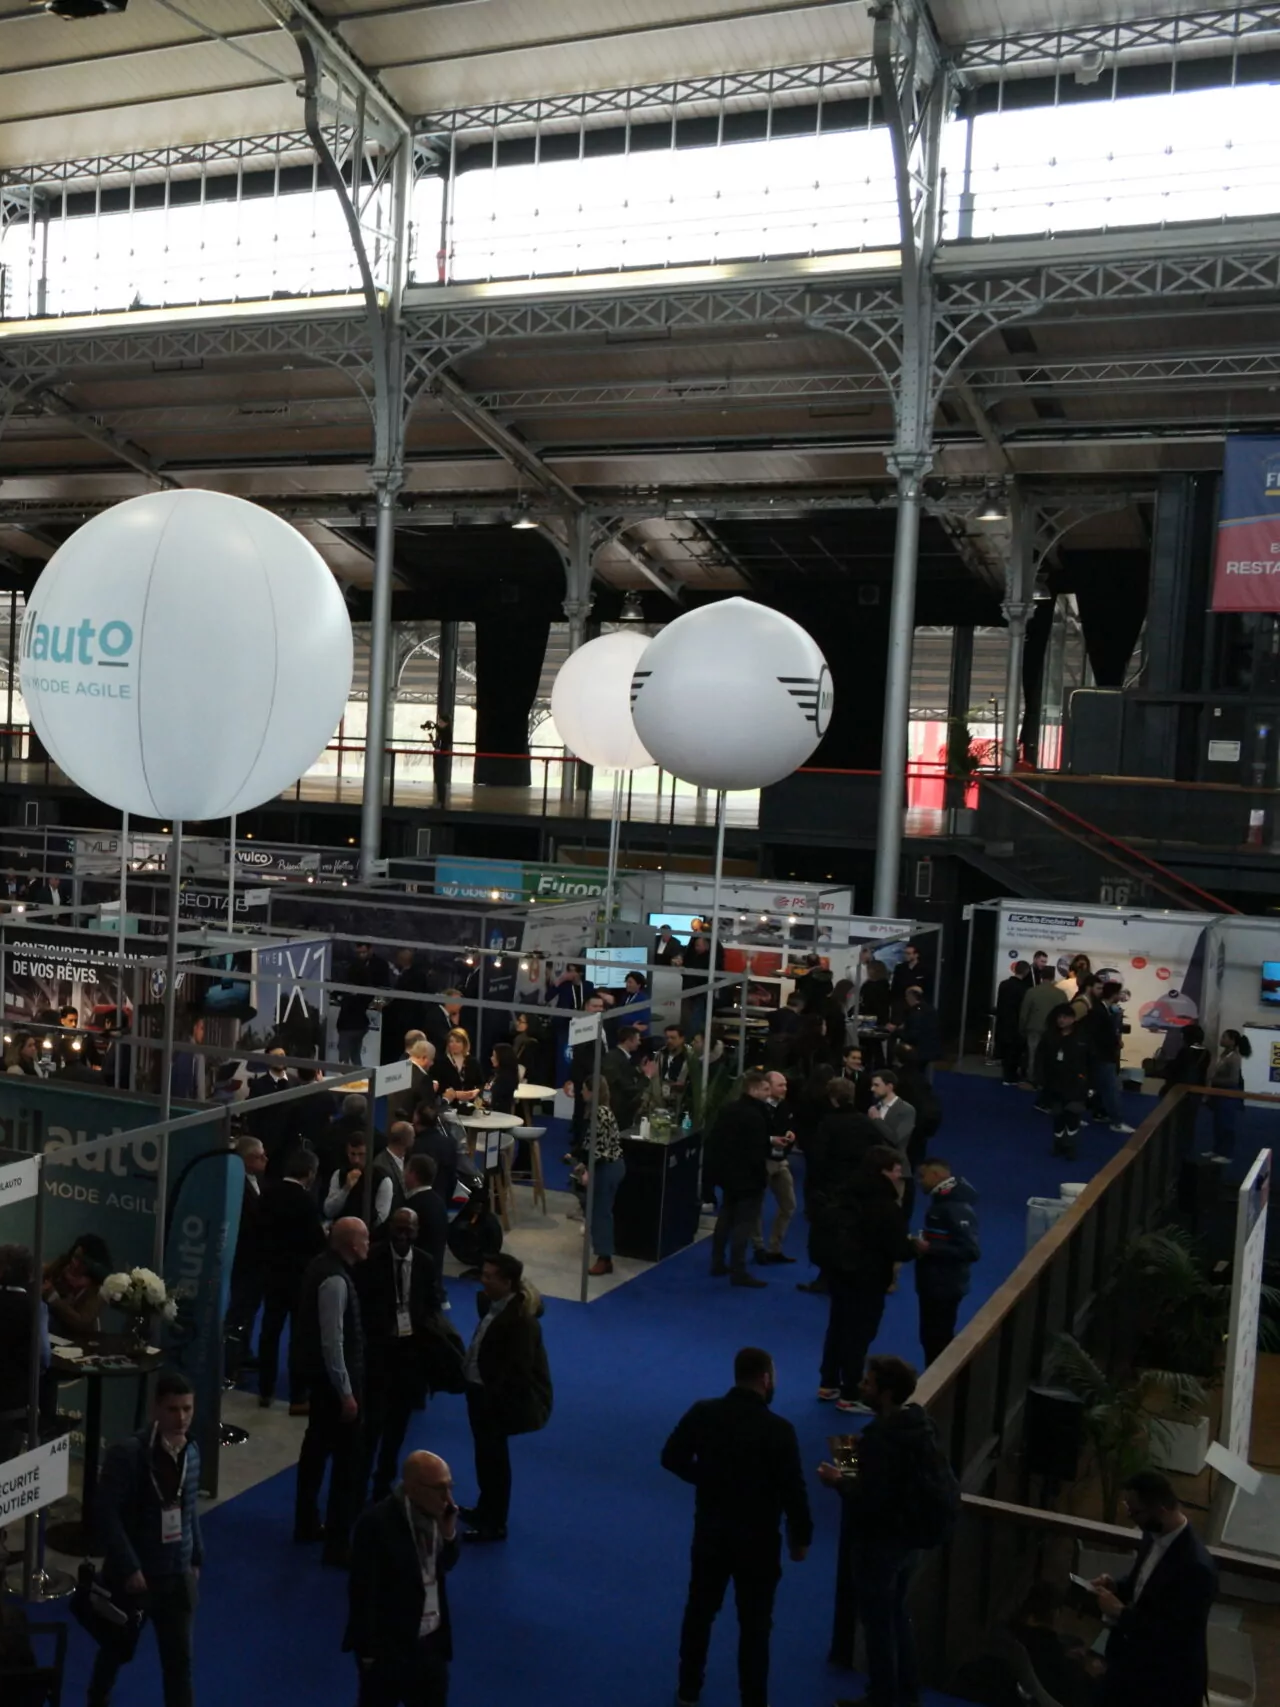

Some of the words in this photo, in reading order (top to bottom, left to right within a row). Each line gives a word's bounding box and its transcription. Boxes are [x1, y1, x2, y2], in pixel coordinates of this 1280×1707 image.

[31, 678, 71, 695] MODE
[75, 681, 132, 700] AGILE
[237, 851, 269, 864] vulco
[12, 959, 28, 976] DE
[29, 961, 54, 979] VOS
[56, 962, 100, 985] RÊVES.
[44, 1179, 100, 1205] MODE
[48, 1439, 68, 1457] A46
